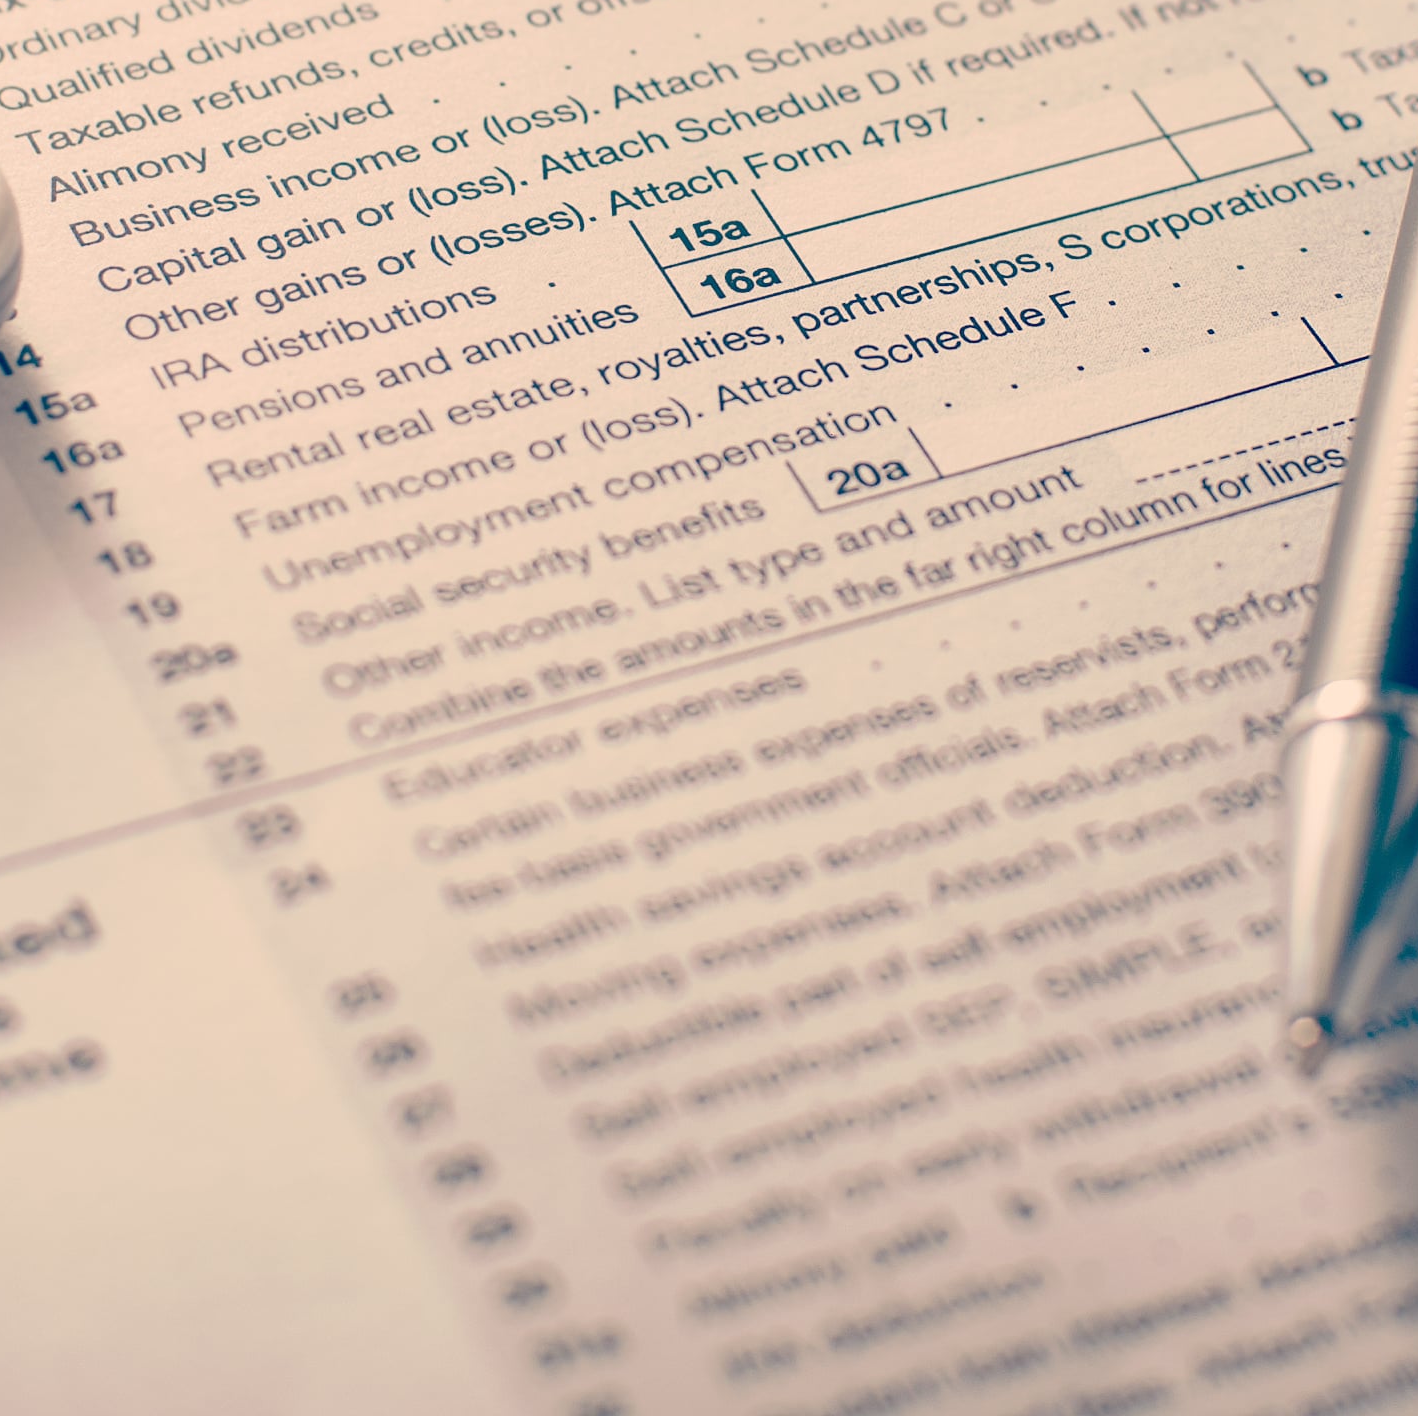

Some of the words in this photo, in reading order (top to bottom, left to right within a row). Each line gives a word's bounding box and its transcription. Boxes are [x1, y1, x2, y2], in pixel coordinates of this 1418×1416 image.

[16, 103, 182, 155] Taxable
[191, 60, 359, 115] refunds,
[368, 19, 517, 68] credits,
[524, 4, 563, 28] or
[185, 1, 380, 65] dividends
[1295, 64, 1329, 88] b
[50, 146, 206, 203] Alimony
[220, 92, 395, 158] received
[68, 187, 261, 247] Business
[265, 144, 421, 198] income
[430, 130, 469, 154] or
[482, 94, 600, 145] (loss).
[612, 60, 740, 110] Attach
[744, 16, 928, 74] Schedule
[932, 0, 968, 28] C
[97, 236, 247, 292] Capital
[256, 217, 346, 260] gain
[355, 203, 394, 227] or
[408, 165, 528, 218] (loss).
[540, 129, 670, 180] Attach
[674, 83, 861, 143] Schedule
[865, 68, 901, 95] D
[906, 57, 935, 85] if
[944, 16, 1115, 77] required.
[1116, 2, 1148, 32] If
[1329, 108, 1363, 132] b
[123, 297, 238, 340] Other
[254, 265, 367, 315] gains
[376, 250, 416, 275] or
[429, 201, 597, 266] (losses).
[609, 164, 738, 223] Attach
[742, 138, 852, 179] Form
[861, 105, 948, 148] 4797
[668, 218, 751, 252] 15a
[204, 430, 346, 488] Rental
[355, 407, 435, 451] real
[446, 377, 589, 426] estate,
[596, 325, 785, 385] royalties,
[790, 252, 1054, 340] partnerships,
[1057, 233, 1092, 260] S
[1100, 170, 1356, 250] corporations,
[699, 266, 782, 299] 16a
[149, 351, 232, 390] IRA
[240, 285, 497, 367] distributions
[176, 376, 366, 439] Pensions
[375, 346, 453, 389] and
[461, 303, 639, 365] annuities
[14, 391, 98, 426] 15a
[41, 440, 125, 475] 16a
[231, 493, 350, 540] Farm
[354, 450, 516, 507] income
[527, 433, 567, 462] or
[580, 396, 704, 452] (loss).
[717, 357, 849, 412] Attach
[853, 305, 1046, 371] Schedule
[1048, 289, 1076, 319] F
[68, 488, 117, 526] 17
[260, 481, 594, 592] Unemployment
[602, 404, 897, 500] compensation
[826, 460, 910, 496] 20a
[95, 541, 154, 575] 18
[124, 592, 181, 626] 19
[290, 584, 425, 646] Social
[431, 543, 592, 605] security
[597, 498, 766, 560] benefits
[320, 643, 445, 699] Other
[455, 597, 634, 659] income.
[636, 565, 722, 611] List
[726, 541, 825, 585] type
[834, 508, 916, 556] and
[924, 464, 1083, 530] amount
[613, 607, 787, 674] amounts
[786, 593, 832, 624] in
[831, 575, 902, 611] the
[902, 558, 956, 590] far
[964, 527, 1054, 572] right
[1059, 491, 1199, 546] column
[1199, 475, 1252, 503] for
[1255, 447, 1355, 487] lines
